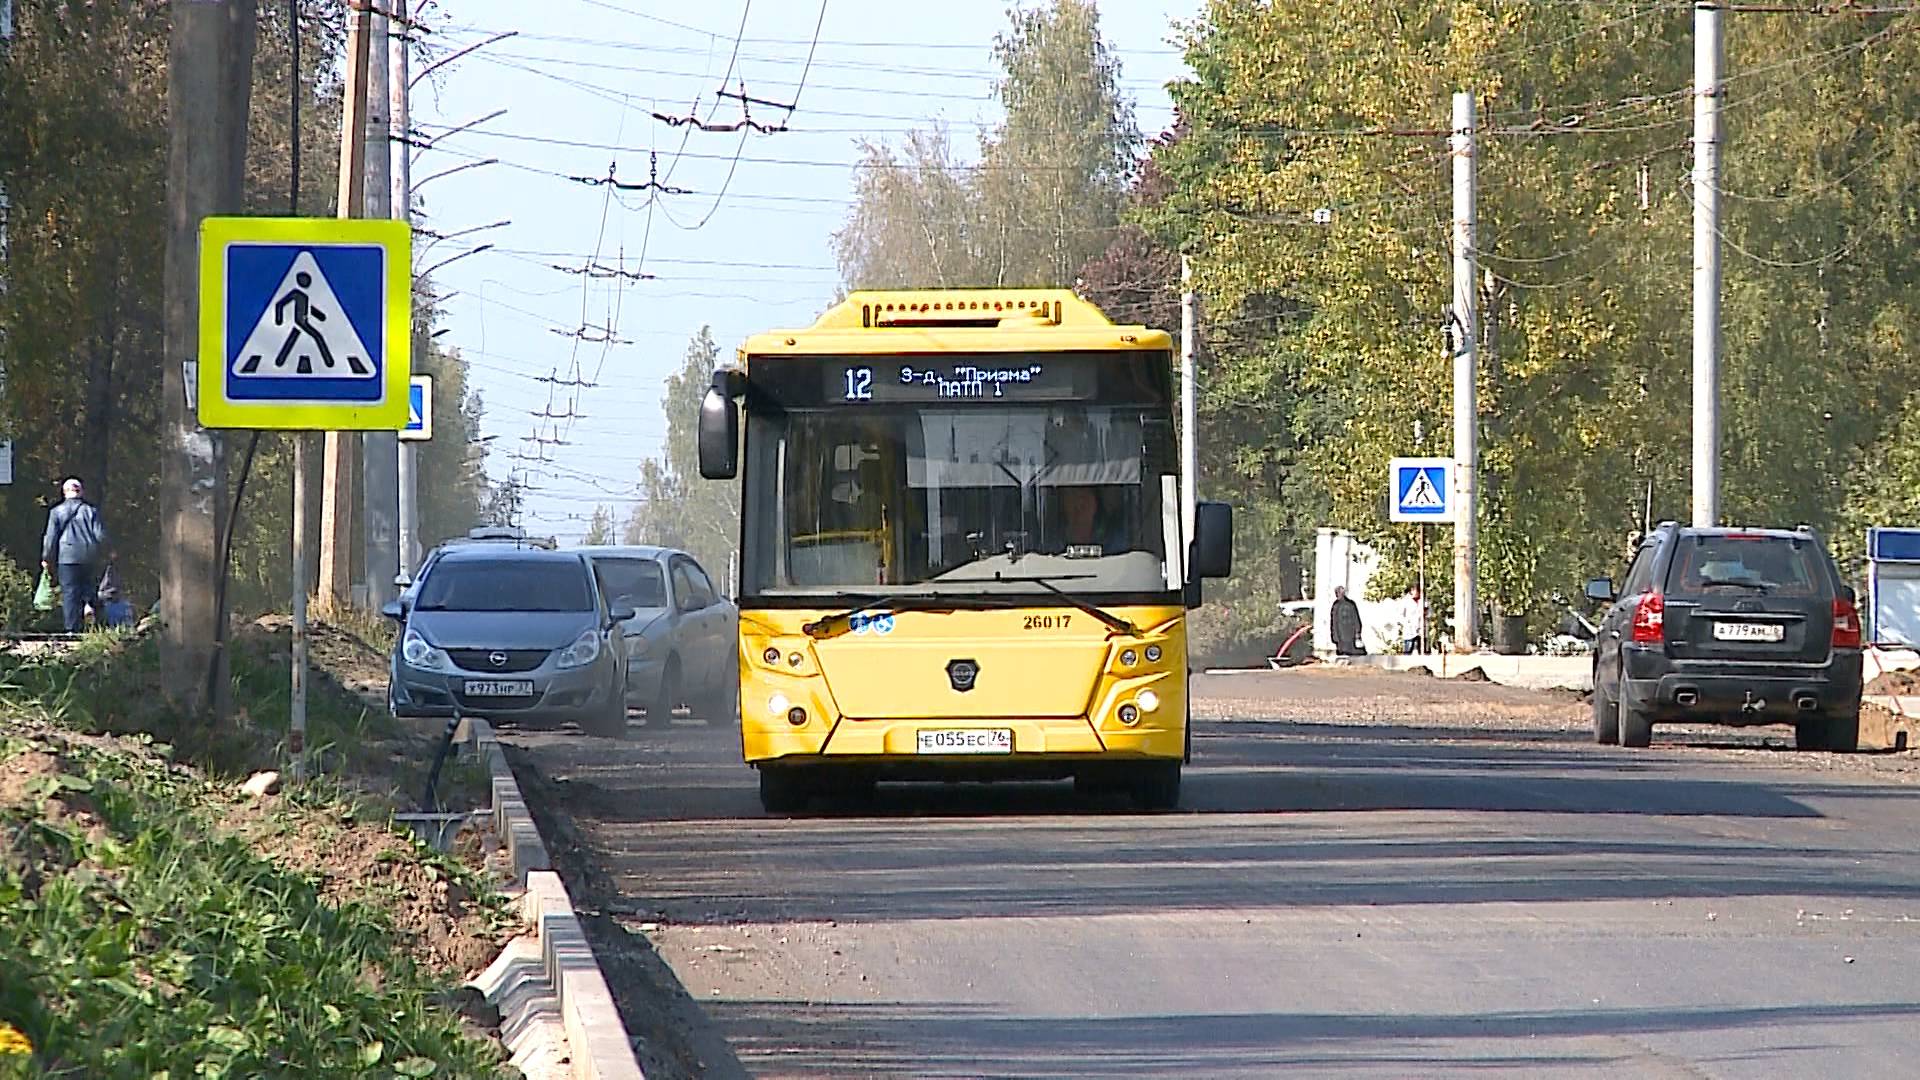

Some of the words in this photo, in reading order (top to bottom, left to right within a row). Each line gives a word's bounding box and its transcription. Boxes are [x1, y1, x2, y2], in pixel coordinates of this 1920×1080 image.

[846, 368, 873, 399] 12
[938, 380, 984, 397] ПАТП
[994, 381, 1004, 397] 1
[1023, 614, 1072, 630] 26017
